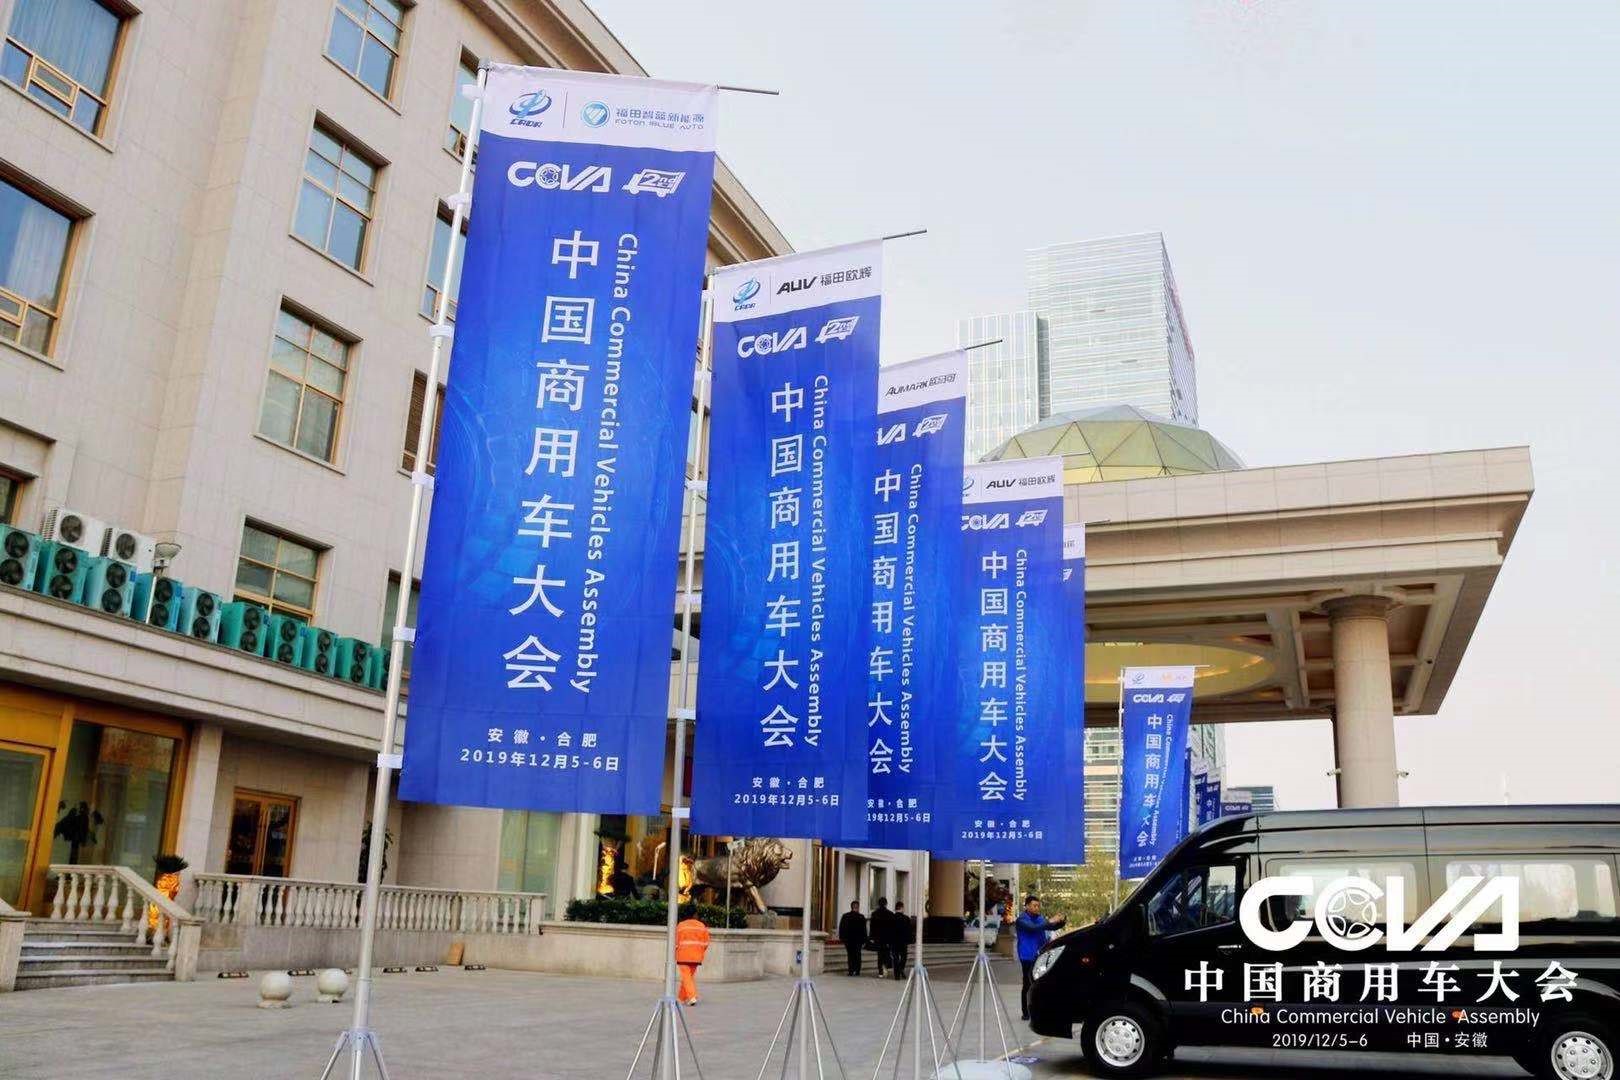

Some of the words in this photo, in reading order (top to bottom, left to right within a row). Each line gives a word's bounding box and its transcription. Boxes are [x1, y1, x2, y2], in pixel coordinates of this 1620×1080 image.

[508, 161, 612, 193] CCVA
[613, 233, 638, 299] China
[820, 266, 873, 287] 福田欧辉
[599, 306, 631, 449] Commercial
[813, 375, 829, 430] China
[503, 230, 600, 692] 中国商用车大会
[811, 435, 827, 552] Commercial
[908, 463, 923, 509] China
[587, 457, 617, 560] Vehicles
[760, 382, 804, 747] 中国商用车大会
[811, 558, 826, 642] Vehicles
[903, 513, 919, 611] Commercial
[1016, 549, 1027, 587] China
[570, 568, 606, 693] Assembly
[868, 469, 901, 774] 中国商用车大会
[902, 615, 915, 686] Vehicles
[1015, 590, 1027, 671] Commercial
[804, 648, 824, 747] Assembly
[978, 551, 1008, 801] 中国商用车大会
[1015, 674, 1027, 731] Vehicles
[460, 748, 620, 771] 2019年12月5-6日
[487, 727, 597, 748] 安徽·合肥
[898, 691, 914, 773] Assembly
[1013, 735, 1027, 801] Assembly
[734, 793, 839, 807] 2019年12月5-6日
